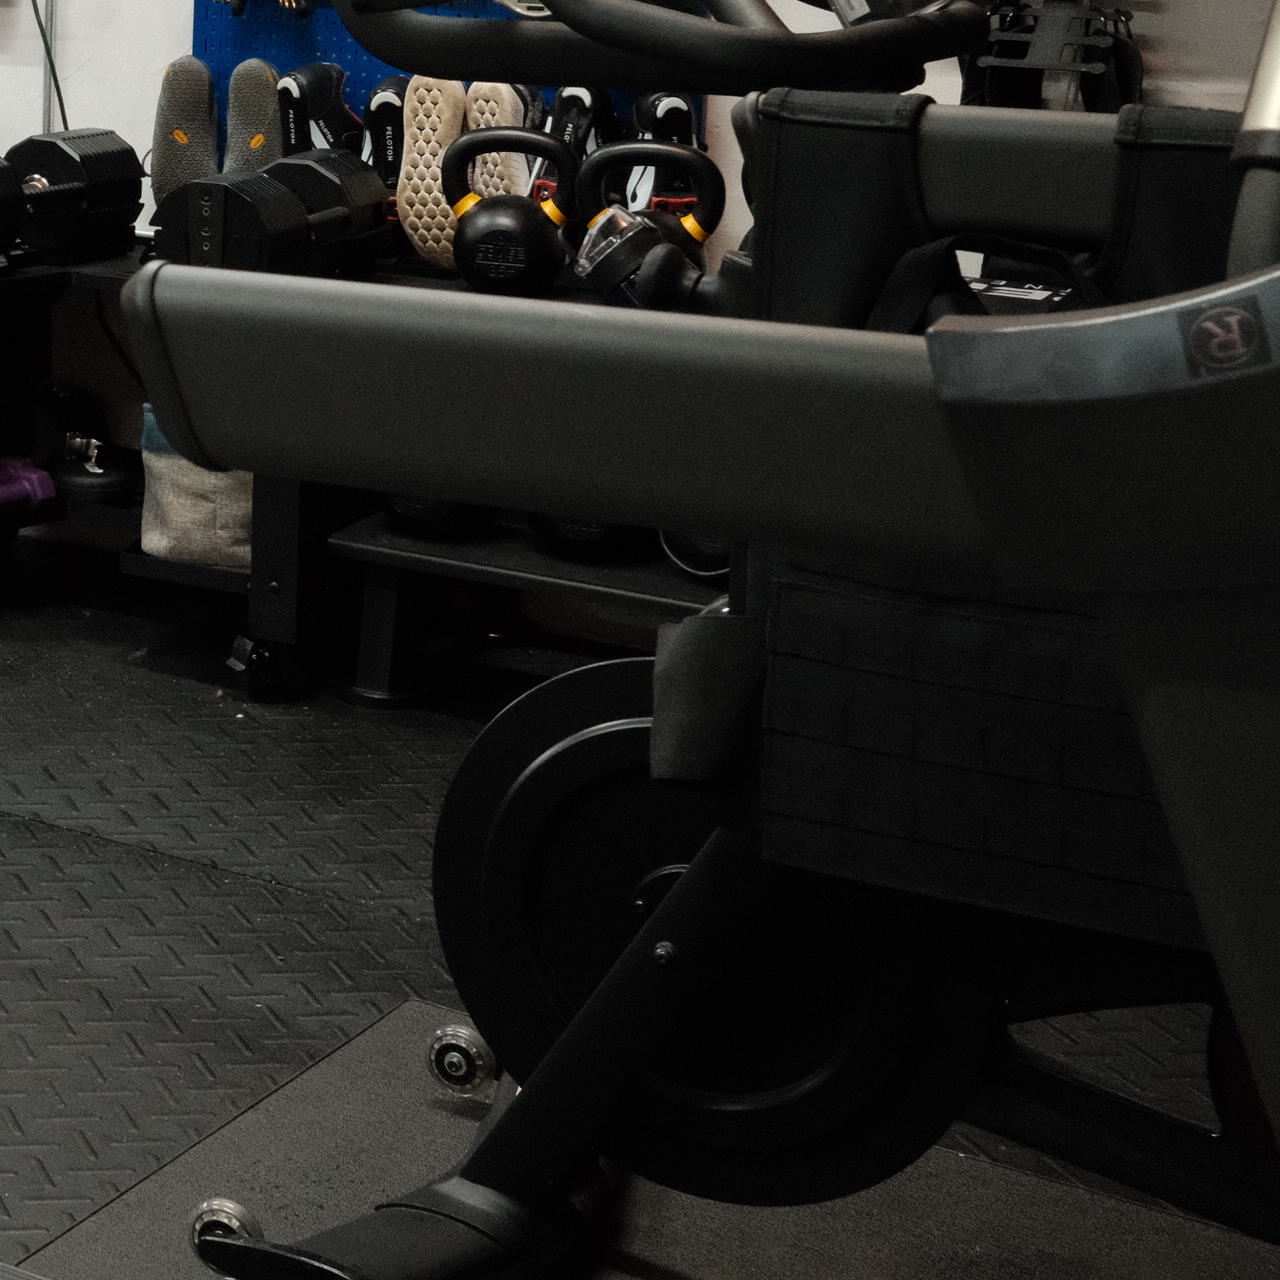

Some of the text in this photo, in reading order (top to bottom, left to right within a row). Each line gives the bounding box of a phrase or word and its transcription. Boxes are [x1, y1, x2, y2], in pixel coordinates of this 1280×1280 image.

[288, 109, 296, 144] PELOTON
[318, 119, 335, 143] PELOTON
[385, 126, 394, 161] PELOTON
